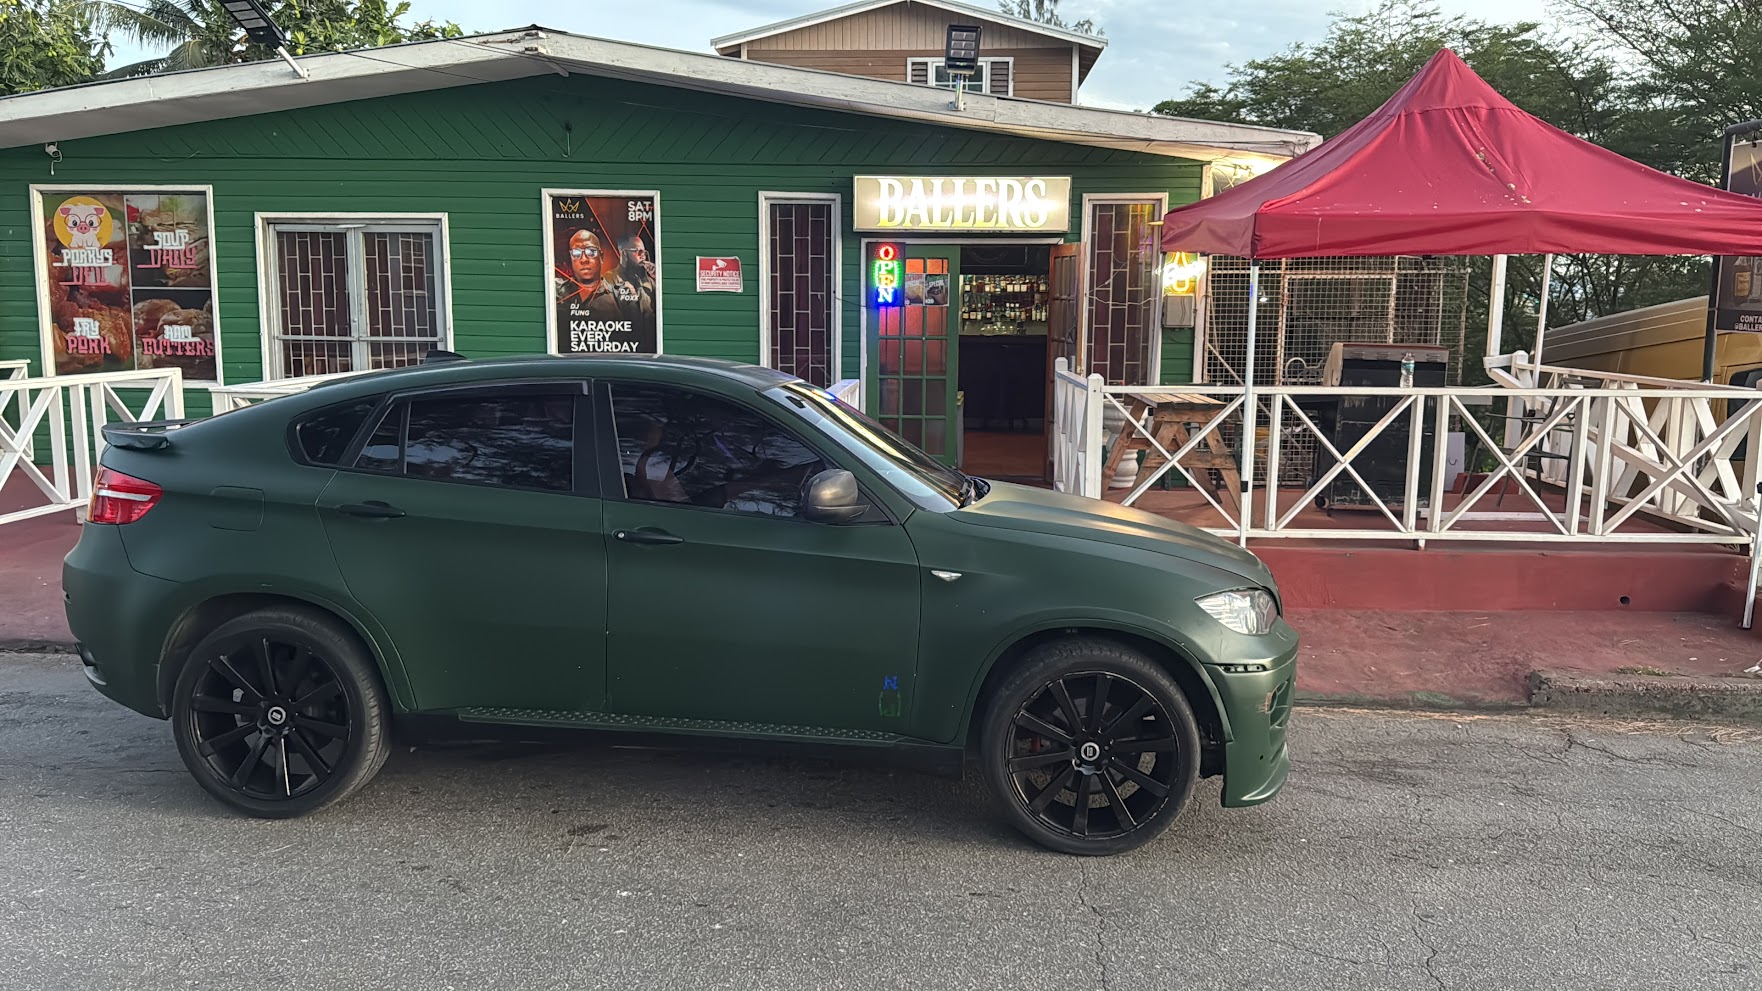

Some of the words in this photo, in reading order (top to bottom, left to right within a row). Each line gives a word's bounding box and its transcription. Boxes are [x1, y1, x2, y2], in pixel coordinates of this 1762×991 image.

[628, 201, 652, 212] SAT
[877, 178, 1048, 228] BALLERS
[628, 211, 653, 221] 8PM
[143, 229, 189, 250] SOUP
[53, 247, 113, 267] PORKYS
[877, 245, 895, 303] OPEN
[163, 324, 201, 342] HAM
[570, 320, 632, 332] KARAOKE
[66, 336, 111, 354] PORK
[570, 331, 612, 342] EVERY
[570, 341, 639, 352] SATURDAY
